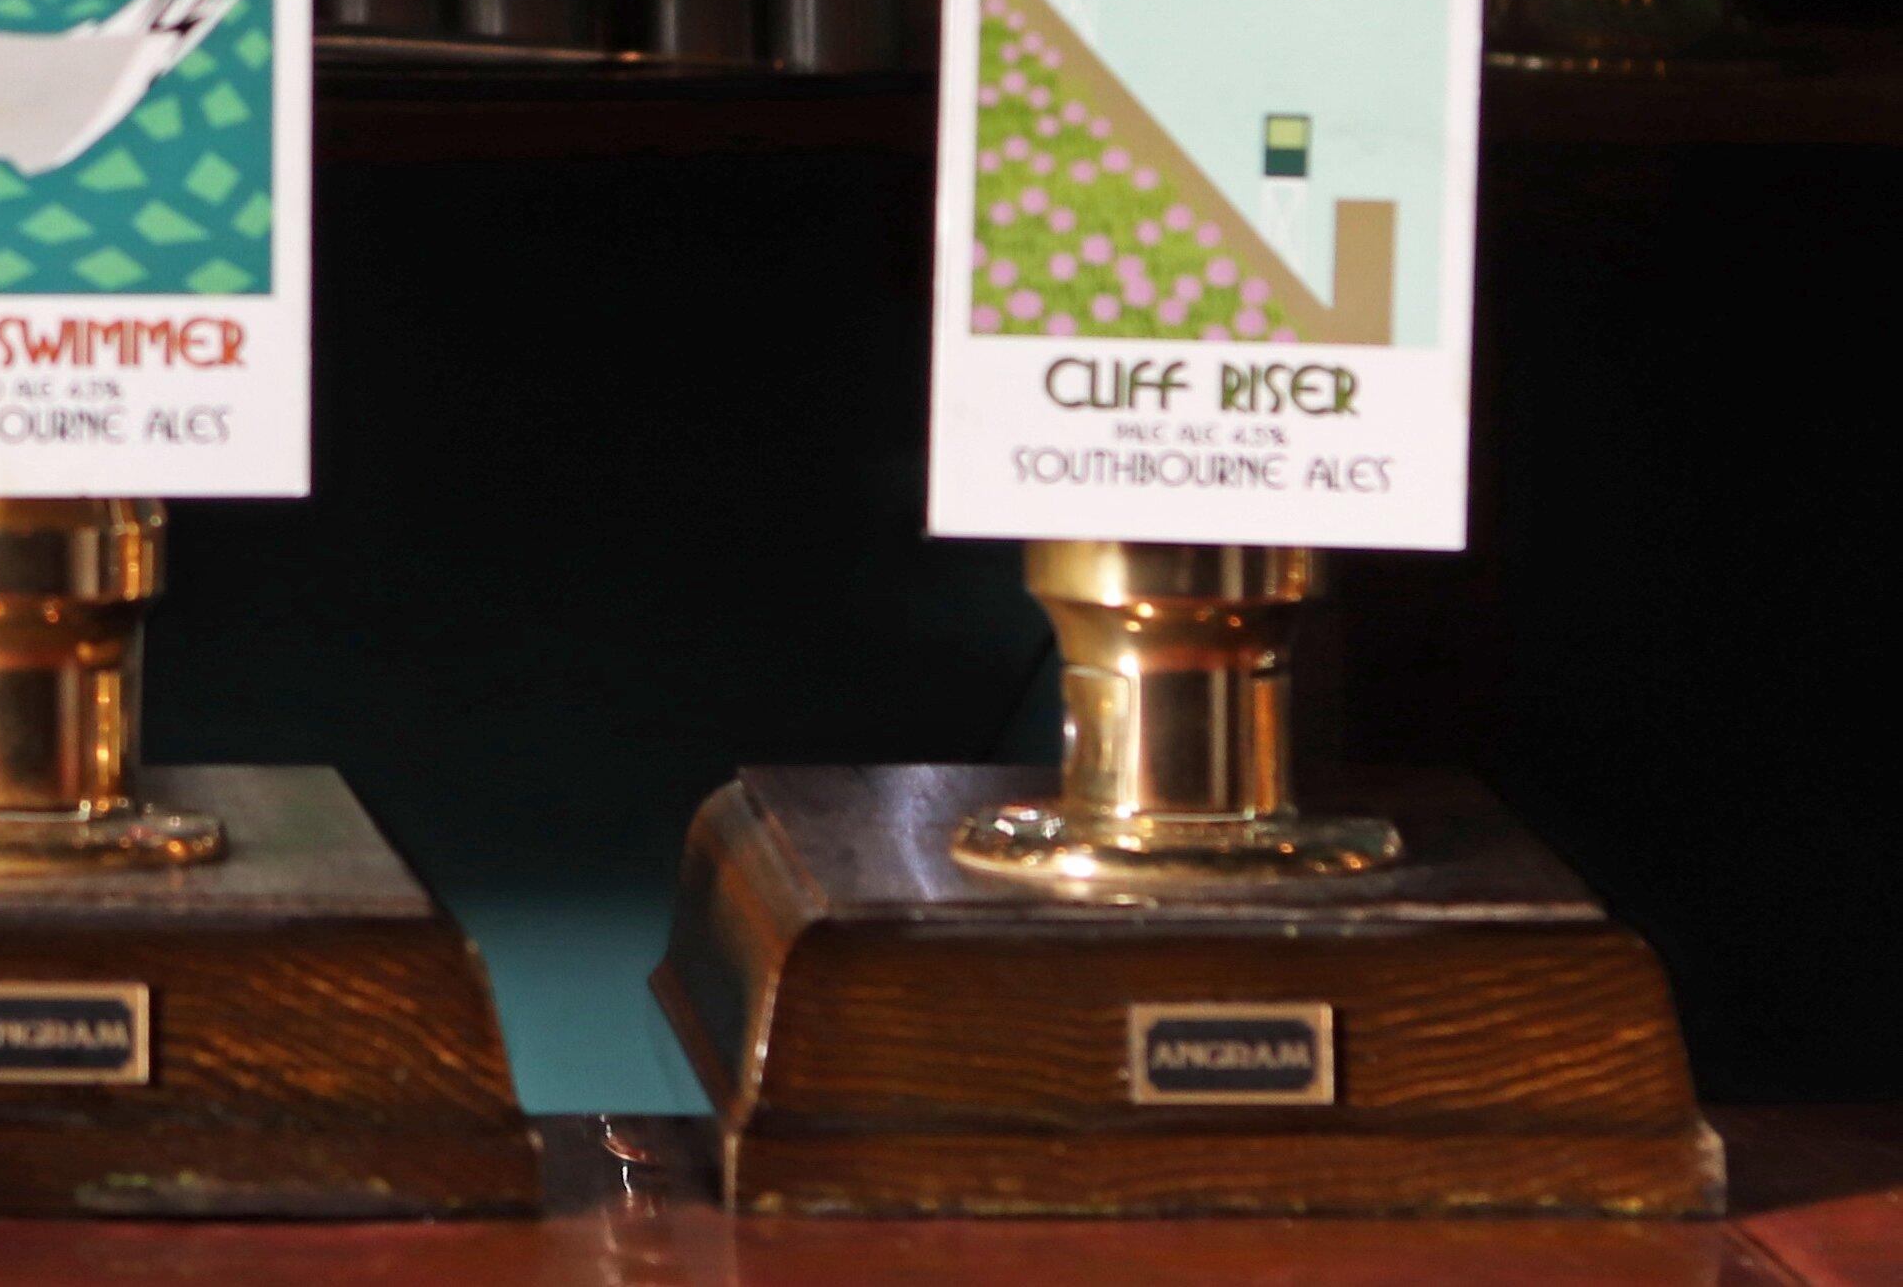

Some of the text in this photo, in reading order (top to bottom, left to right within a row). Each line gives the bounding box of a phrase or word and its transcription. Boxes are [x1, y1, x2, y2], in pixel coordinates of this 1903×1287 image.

[1045, 356, 1361, 417] CLIFF RISER
[144, 404, 232, 443] ALES
[1011, 446, 1395, 493] SOUTHBOURNE ALES
